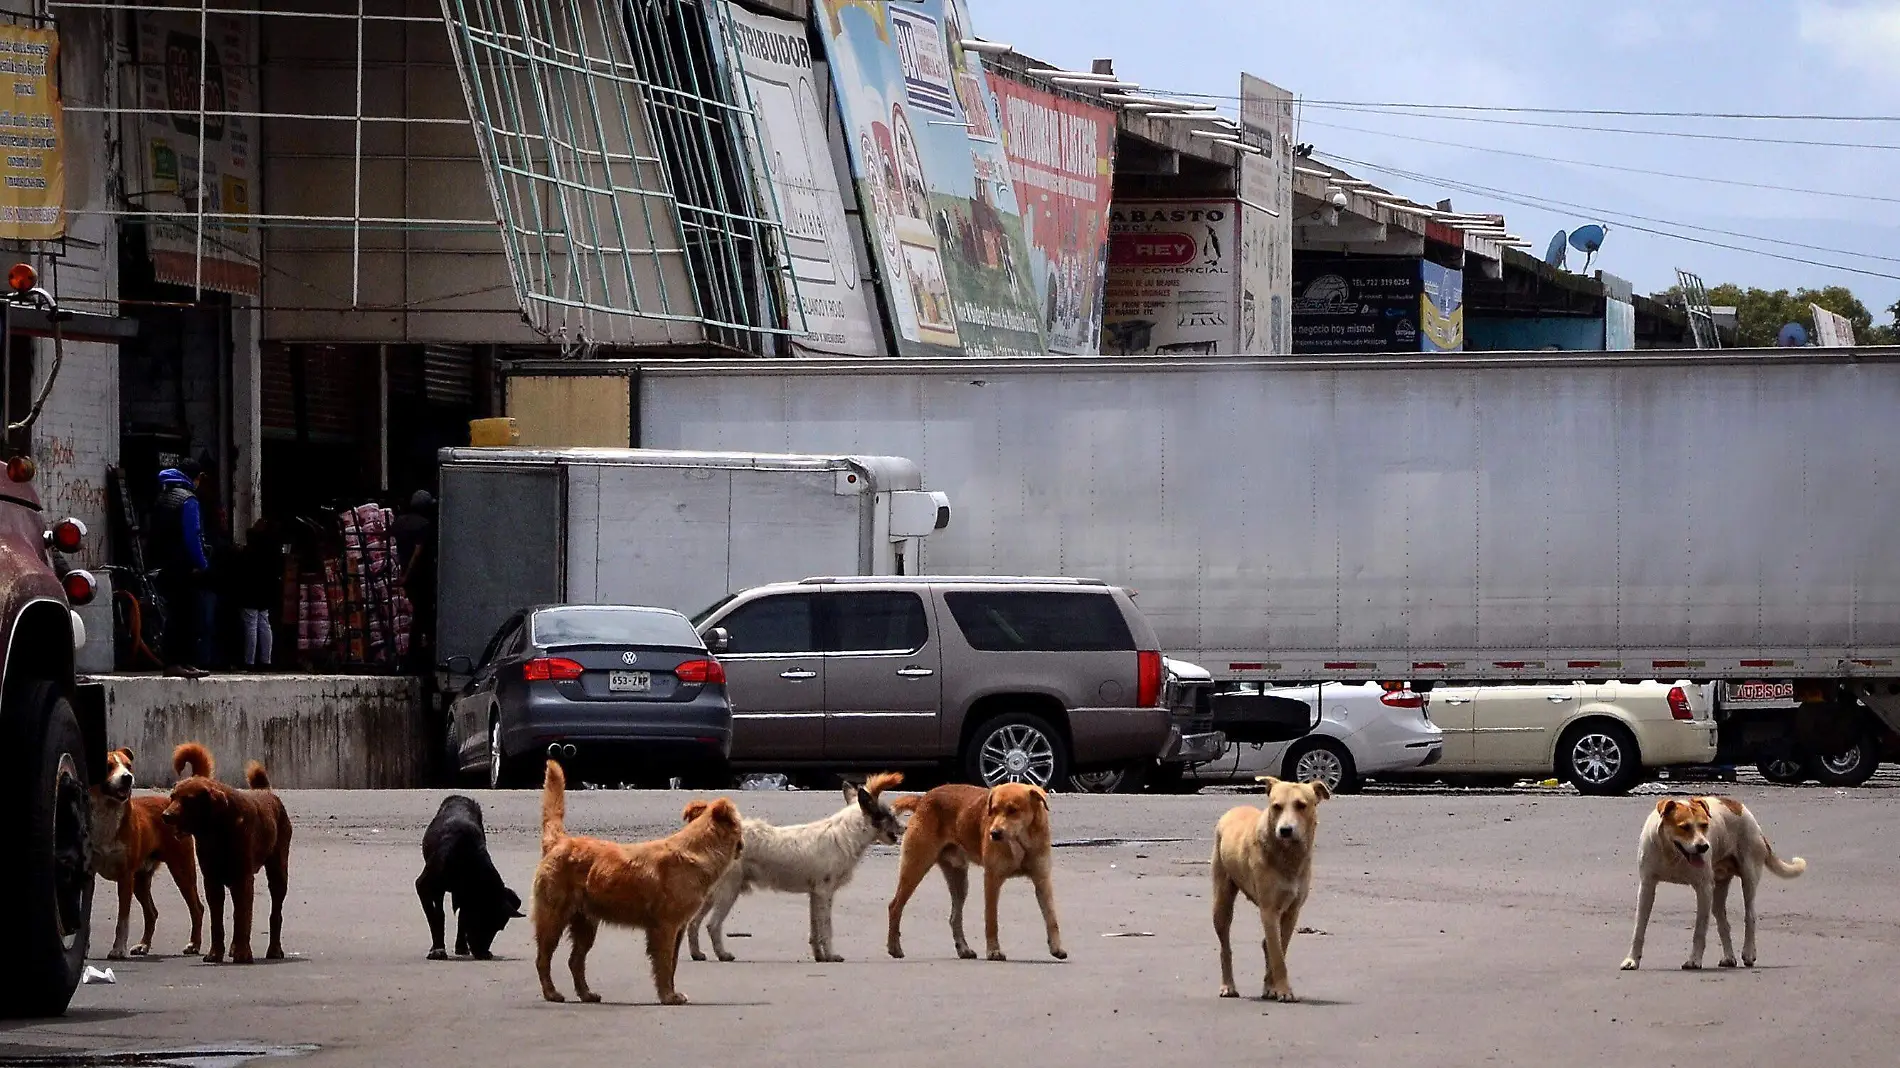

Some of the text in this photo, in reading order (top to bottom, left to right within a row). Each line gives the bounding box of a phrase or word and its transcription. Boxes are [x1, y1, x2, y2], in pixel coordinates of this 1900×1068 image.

[721, 16, 811, 69] DSTRIBUIDOR
[1111, 210, 1224, 222] ABASTO
[1136, 244, 1187, 256] REY
[1299, 324, 1330, 336] negocio
[1331, 323, 1346, 335] hoy
[1347, 323, 1375, 333] mismo!
